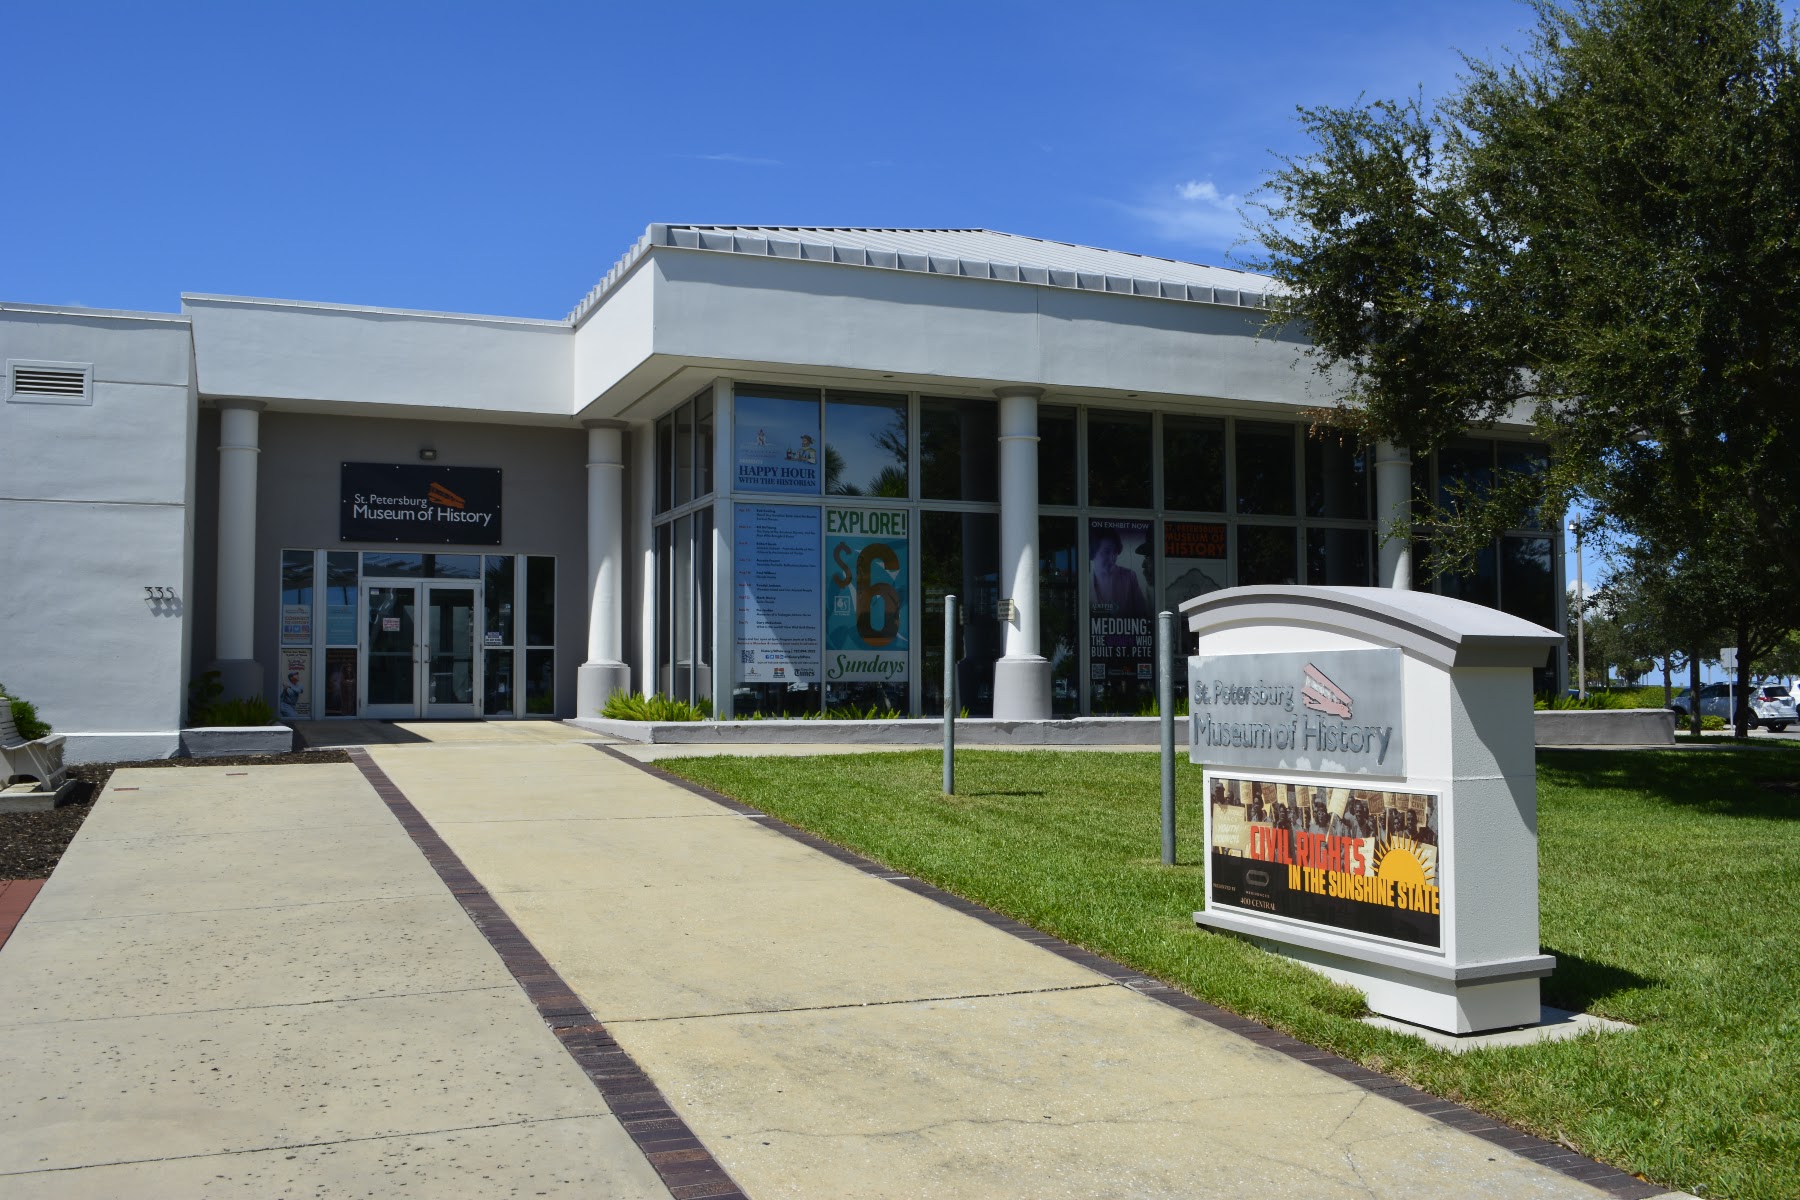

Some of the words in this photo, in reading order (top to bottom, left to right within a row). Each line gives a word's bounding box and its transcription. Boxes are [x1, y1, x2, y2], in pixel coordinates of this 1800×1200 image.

[739, 465, 779, 478] HAPPY
[781, 467, 816, 480] HOUR
[738, 477, 759, 485] WITH
[760, 478, 776, 486] THE
[777, 479, 816, 488] HISTORIAN
[354, 493, 368, 504] St.
[370, 494, 428, 508] Petersburg
[353, 504, 415, 520] Museum
[417, 507, 434, 521] of
[437, 507, 492, 527] History
[827, 509, 906, 536] EXPLORE!
[1104, 521, 1130, 529] EXHIBIT
[1131, 522, 1149, 530] NOW
[1165, 532, 1209, 543] MUSEUM
[1211, 534, 1225, 544] OF
[1165, 543, 1226, 557] HISTORY
[144, 586, 175, 601] 335
[1091, 617, 1152, 635] MEDDLING:
[1091, 635, 1106, 646] THE
[1136, 635, 1153, 647] WHO
[1091, 646, 1113, 657] BUILT
[1116, 646, 1130, 658] ST.
[1132, 646, 1152, 658] PETE
[827, 653, 905, 680] Sundays
[1194, 680, 1211, 706] St.
[1213, 679, 1295, 712] Petersburg
[1193, 712, 1272, 750] Museum
[1273, 714, 1298, 750] of
[1302, 714, 1393, 766] History
[1250, 824, 1293, 865] CIVIL
[1296, 831, 1365, 876] RIGHTS
[1288, 863, 1301, 891] IN
[1303, 865, 1326, 896] THE
[1328, 870, 1395, 908] SUNSHINE
[1397, 879, 1440, 915] STATE
[1240, 897, 1251, 905] 400
[1251, 898, 1276, 911] CENTRAL
